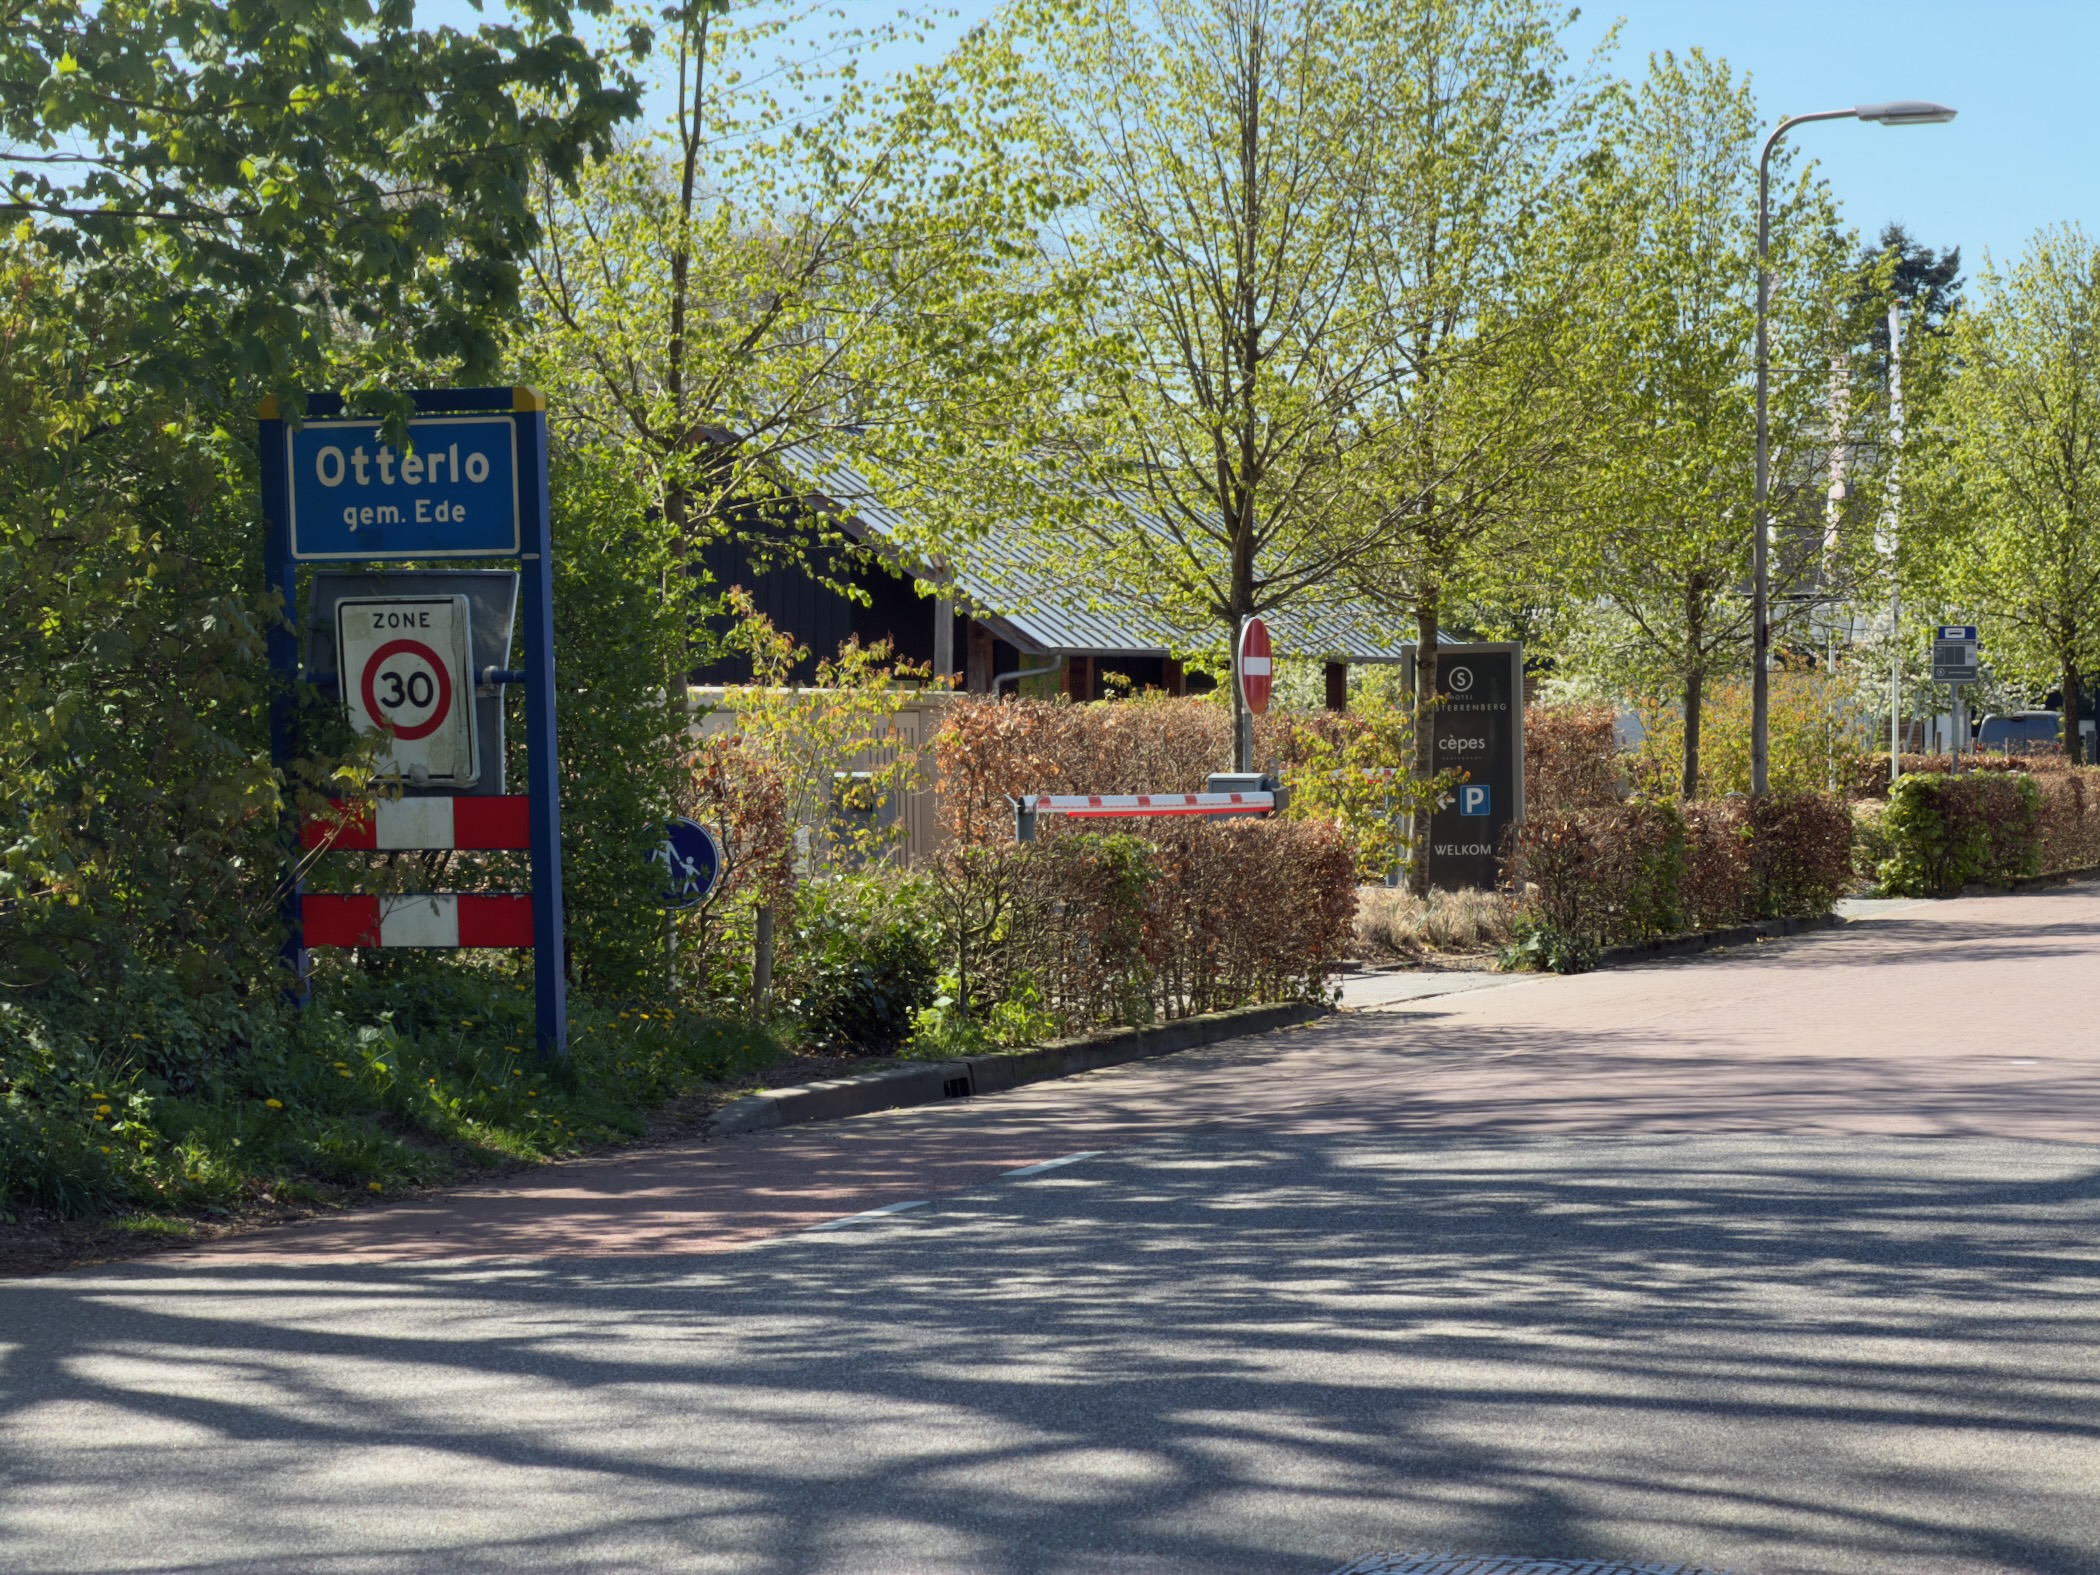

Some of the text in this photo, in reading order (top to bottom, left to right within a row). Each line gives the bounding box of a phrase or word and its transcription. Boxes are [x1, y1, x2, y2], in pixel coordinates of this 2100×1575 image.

[315, 442, 490, 488] Otterlo
[343, 499, 466, 532] gem. Ede
[372, 612, 431, 629] ZONE
[380, 671, 434, 708] 30
[1435, 703, 1507, 712] STERRENBERG
[1438, 733, 1486, 754] cèpes
[1466, 787, 1484, 814] P
[1434, 843, 1492, 856] WELKOM
